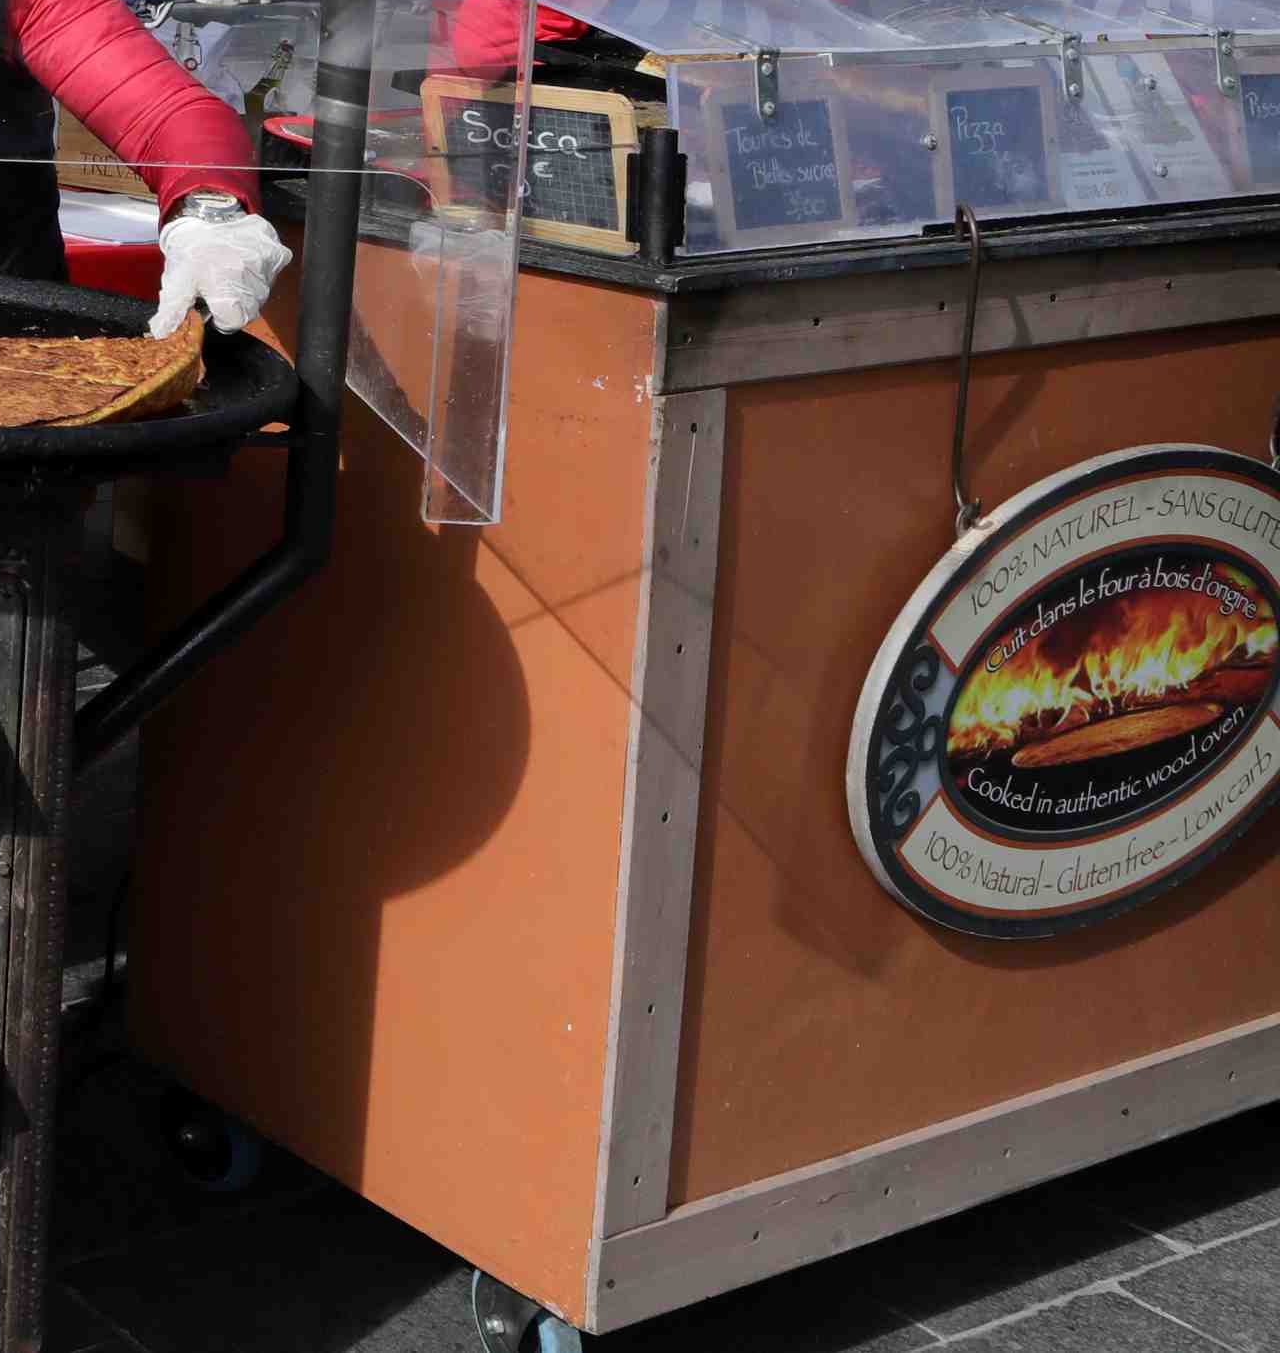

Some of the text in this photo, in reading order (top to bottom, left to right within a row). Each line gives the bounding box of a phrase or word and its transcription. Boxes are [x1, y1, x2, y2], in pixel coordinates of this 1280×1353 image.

[950, 105, 1006, 155] Pizza
[971, 551, 1028, 616] 100%
[1032, 496, 1141, 568] NATUREL
[1157, 489, 1217, 519] SANS
[987, 557, 1258, 673] Cuit dans le four à bois d'origine
[968, 706, 1246, 815] Cooked in authentic wood oven
[924, 830, 972, 881] 100%
[971, 857, 1044, 897] Natural
[1057, 855, 1121, 895] Gluten
[1124, 836, 1166, 876] free
[1183, 795, 1225, 841] Low
[1225, 745, 1273, 803] carb
